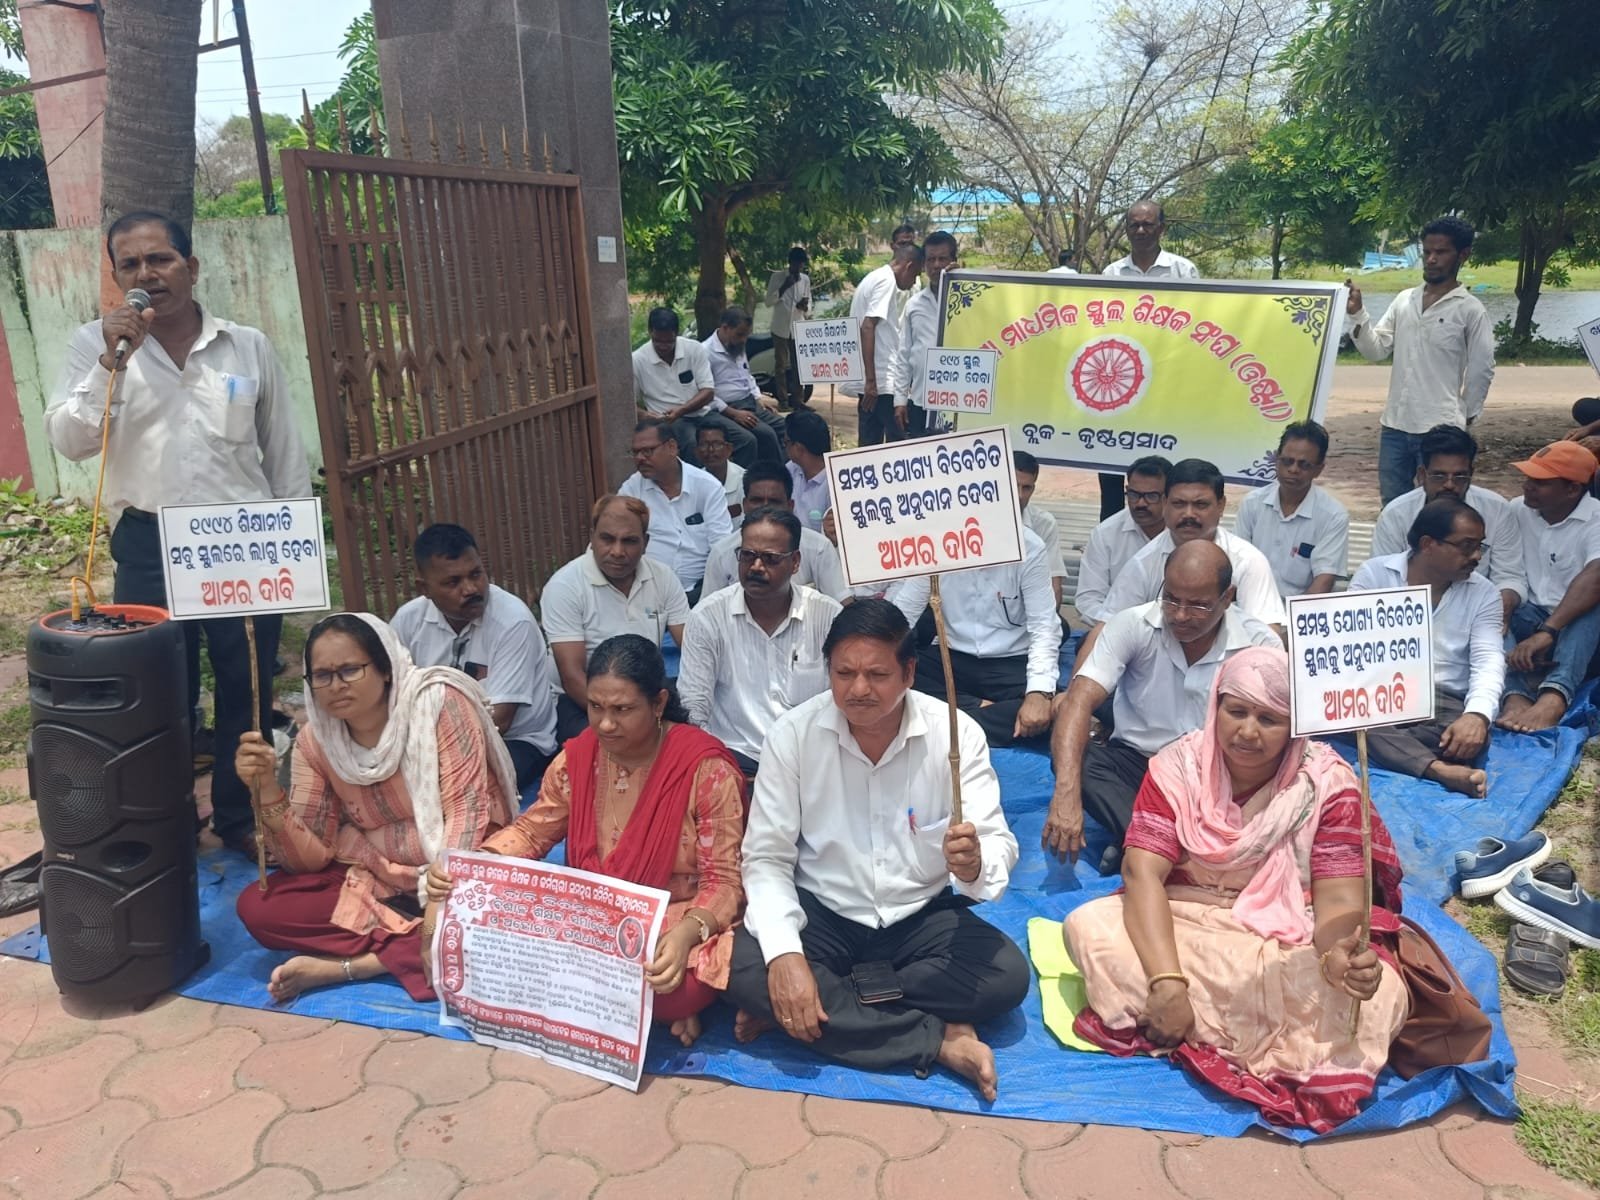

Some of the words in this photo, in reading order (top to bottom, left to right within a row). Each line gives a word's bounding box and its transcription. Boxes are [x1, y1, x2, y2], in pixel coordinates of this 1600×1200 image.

[1000, 303, 1078, 346] ମାଧ୍ୟମିକ
[1086, 300, 1125, 326] ସ୍କୁଲ
[1133, 294, 1191, 331] ଶିକ୍ଷକ
[1190, 321, 1240, 358] ସଂଘ
[811, 363, 832, 378] ଆମର
[834, 357, 849, 376] ଦାବି
[929, 370, 959, 384] ଅନୁଦାନ
[965, 372, 990, 384] ଦେବା
[963, 356, 980, 370] ସ୍କୁଲ
[928, 391, 958, 407] ଆମର
[963, 389, 988, 408] ଦାବି
[1022, 423, 1055, 445] ବ୍ଲକ
[1078, 427, 1177, 450] କୃଷ୍ଣପ୍ରସାଦ
[838, 465, 879, 491] ସମସ୍ତ
[882, 455, 934, 484] ଯୋଗ୍ୟ
[936, 438, 1001, 475] ବିବେଚିତ
[190, 516, 232, 535] ୧୯୯୪
[237, 505, 293, 533] ଶିକ୍ଷାନୀତି
[850, 496, 896, 529] ସ୍କୁଲକୁ
[896, 487, 952, 521] ଅନୁଦାନ
[957, 480, 1000, 507] ଦେବା
[170, 546, 195, 569] ସବୁ
[198, 543, 245, 569] ସ୍କୁଲରେ
[250, 541, 279, 565] ଲାଗୁ
[282, 538, 318, 562] ହେବା
[877, 535, 938, 570] ଆମର
[942, 517, 984, 561] ଦାବି
[201, 579, 254, 606] ଆମର
[258, 567, 294, 602] ଦାବି
[1296, 612, 1330, 637] ସମସ୍ତ
[1333, 607, 1373, 633] ଯୋଗ୍ୟ
[1375, 596, 1424, 629] ବିବେଚିତ
[1304, 646, 1340, 677] ସ୍କୁଲକୁ
[1343, 640, 1386, 671] ଅନୁଦାନ
[1389, 637, 1421, 661] ଦେବା
[1323, 688, 1370, 721] ଆମର
[1375, 672, 1406, 714] ଦାବି
